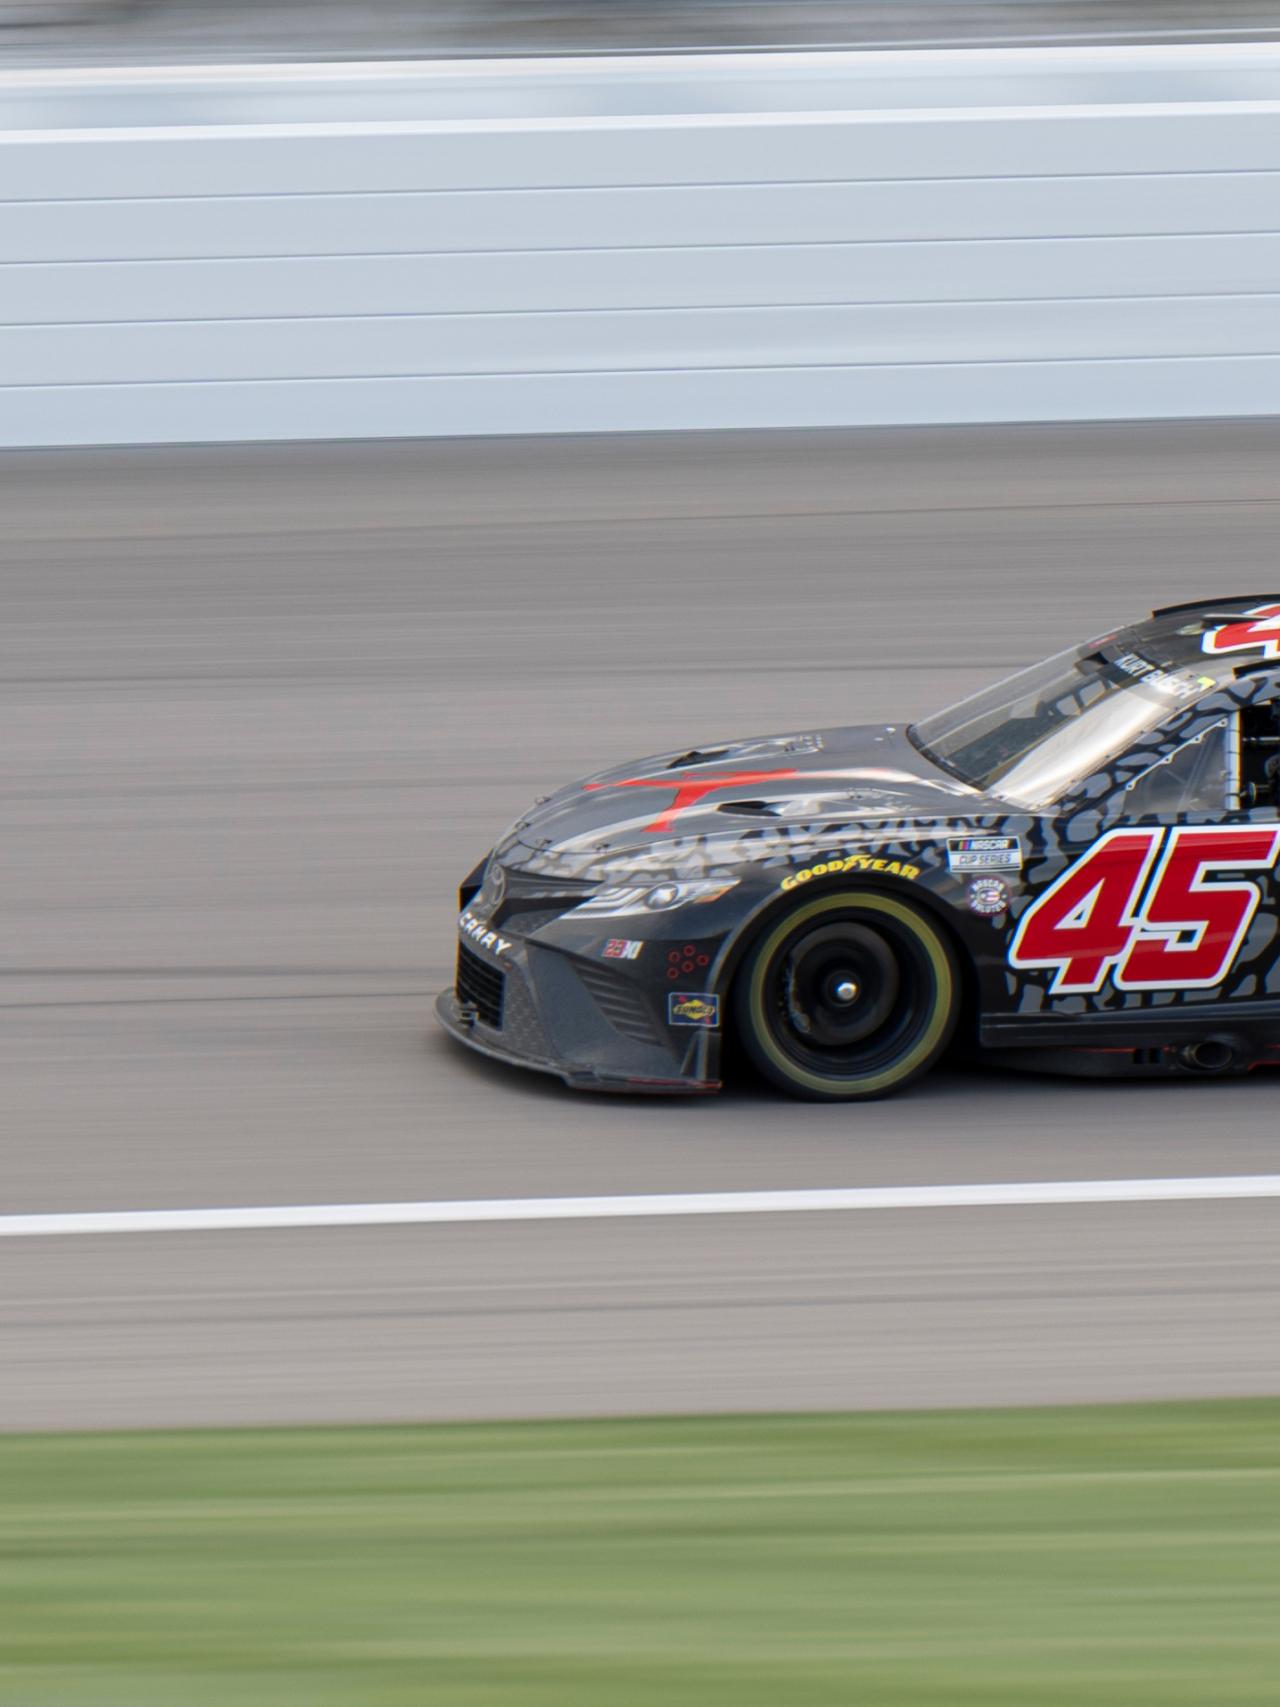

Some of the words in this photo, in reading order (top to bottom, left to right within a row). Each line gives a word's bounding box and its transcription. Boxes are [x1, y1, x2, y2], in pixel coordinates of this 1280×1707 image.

[780, 854, 921, 891] GOODYEAR
[979, 852, 1012, 865] SERIES
[460, 912, 512, 956] CAMRY
